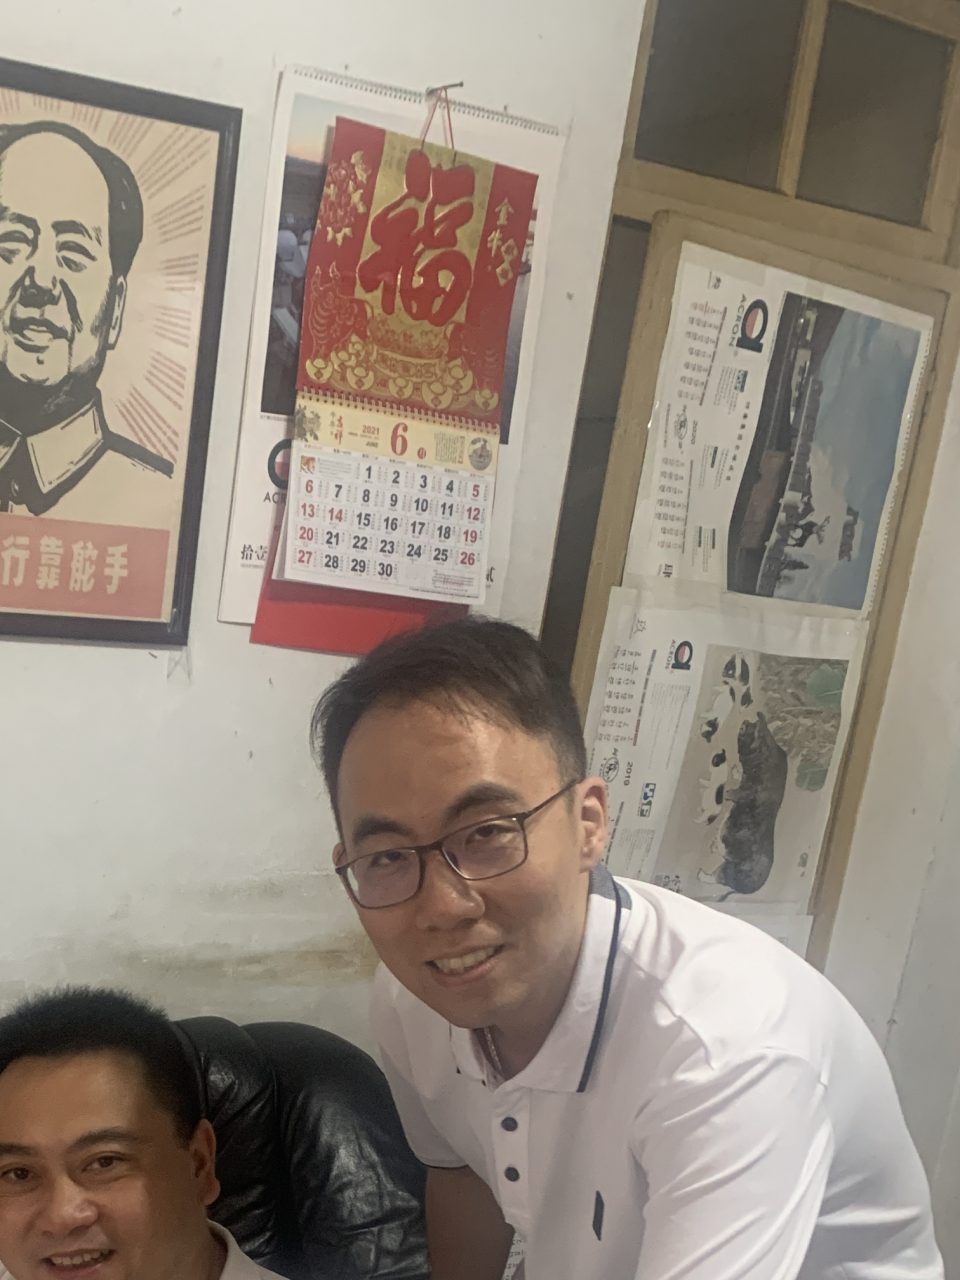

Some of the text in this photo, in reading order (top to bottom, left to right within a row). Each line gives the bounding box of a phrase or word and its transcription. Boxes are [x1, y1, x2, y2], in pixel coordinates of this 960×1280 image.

[357, 149, 476, 327] 福
[729, 294, 747, 347] ACRON
[362, 424, 380, 435] 2021
[390, 422, 408, 456] 6
[306, 480, 480, 521] 6 7 8 9 10 11 12
[366, 466, 372, 479] 1
[392, 471, 400, 484] 2
[420, 475, 427, 488] 3
[446, 480, 454, 493] 4
[472, 485, 479, 497] 5
[301, 503, 477, 543] 13 14 15 16 17 18 19
[298, 550, 392, 576] 27 28 29 30
[299, 527, 474, 565] 20 21 22 23 24 25 26
